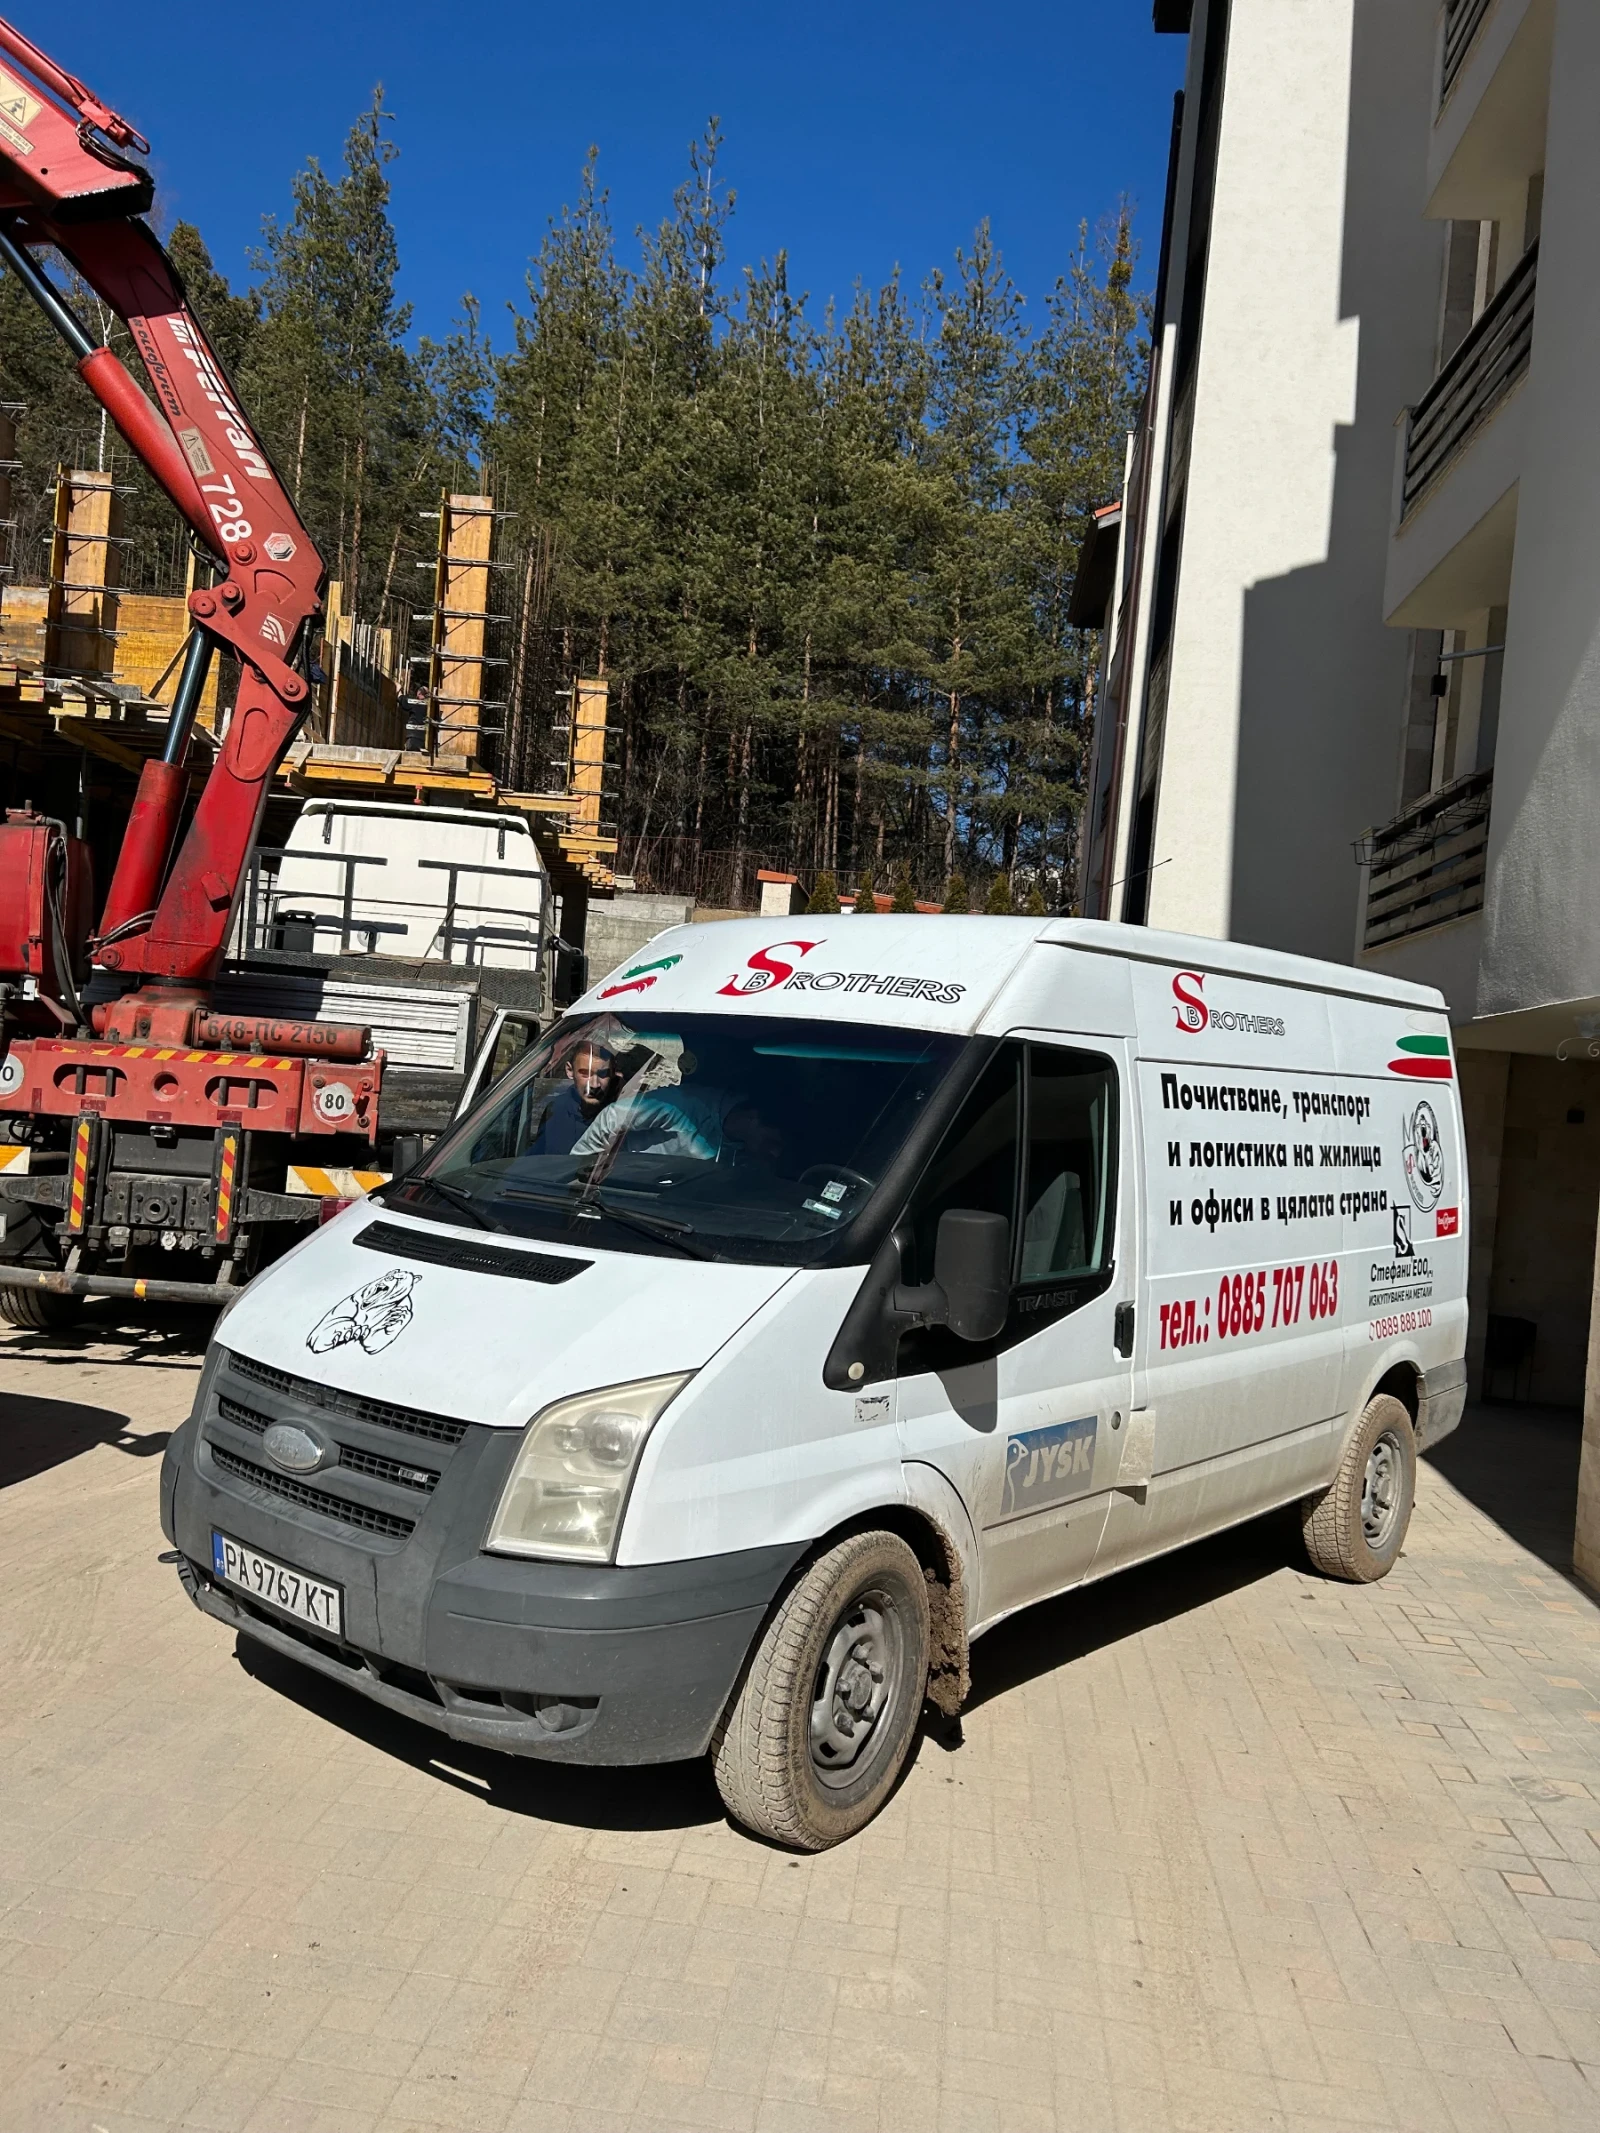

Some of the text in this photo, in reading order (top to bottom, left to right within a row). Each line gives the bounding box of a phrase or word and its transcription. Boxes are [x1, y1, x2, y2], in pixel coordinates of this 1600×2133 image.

[202, 474, 252, 542] 728
[325, 1093, 345, 1110] 80
[1160, 1073, 1370, 1125] Почистване, транспорт
[1167, 1141, 1381, 1172] и логистика на жилища
[1169, 1200, 1182, 1226] и
[1191, 1188, 1254, 1233] офиси
[1260, 1197, 1270, 1221] в
[1277, 1194, 1334, 1226] цялата
[1340, 1189, 1388, 1222] страна
[1370, 1260, 1411, 1284] Стефани
[1160, 1259, 1338, 1350] тел.: 0885 707 063
[1369, 1286, 1432, 1307] ИЗКУПУВАНЕ НА МЕТАЛИ
[1375, 1308, 1432, 1340] 0889 888 100
[1022, 1435, 1095, 1488] JYSK
[252, 1558, 301, 1609] 9767
